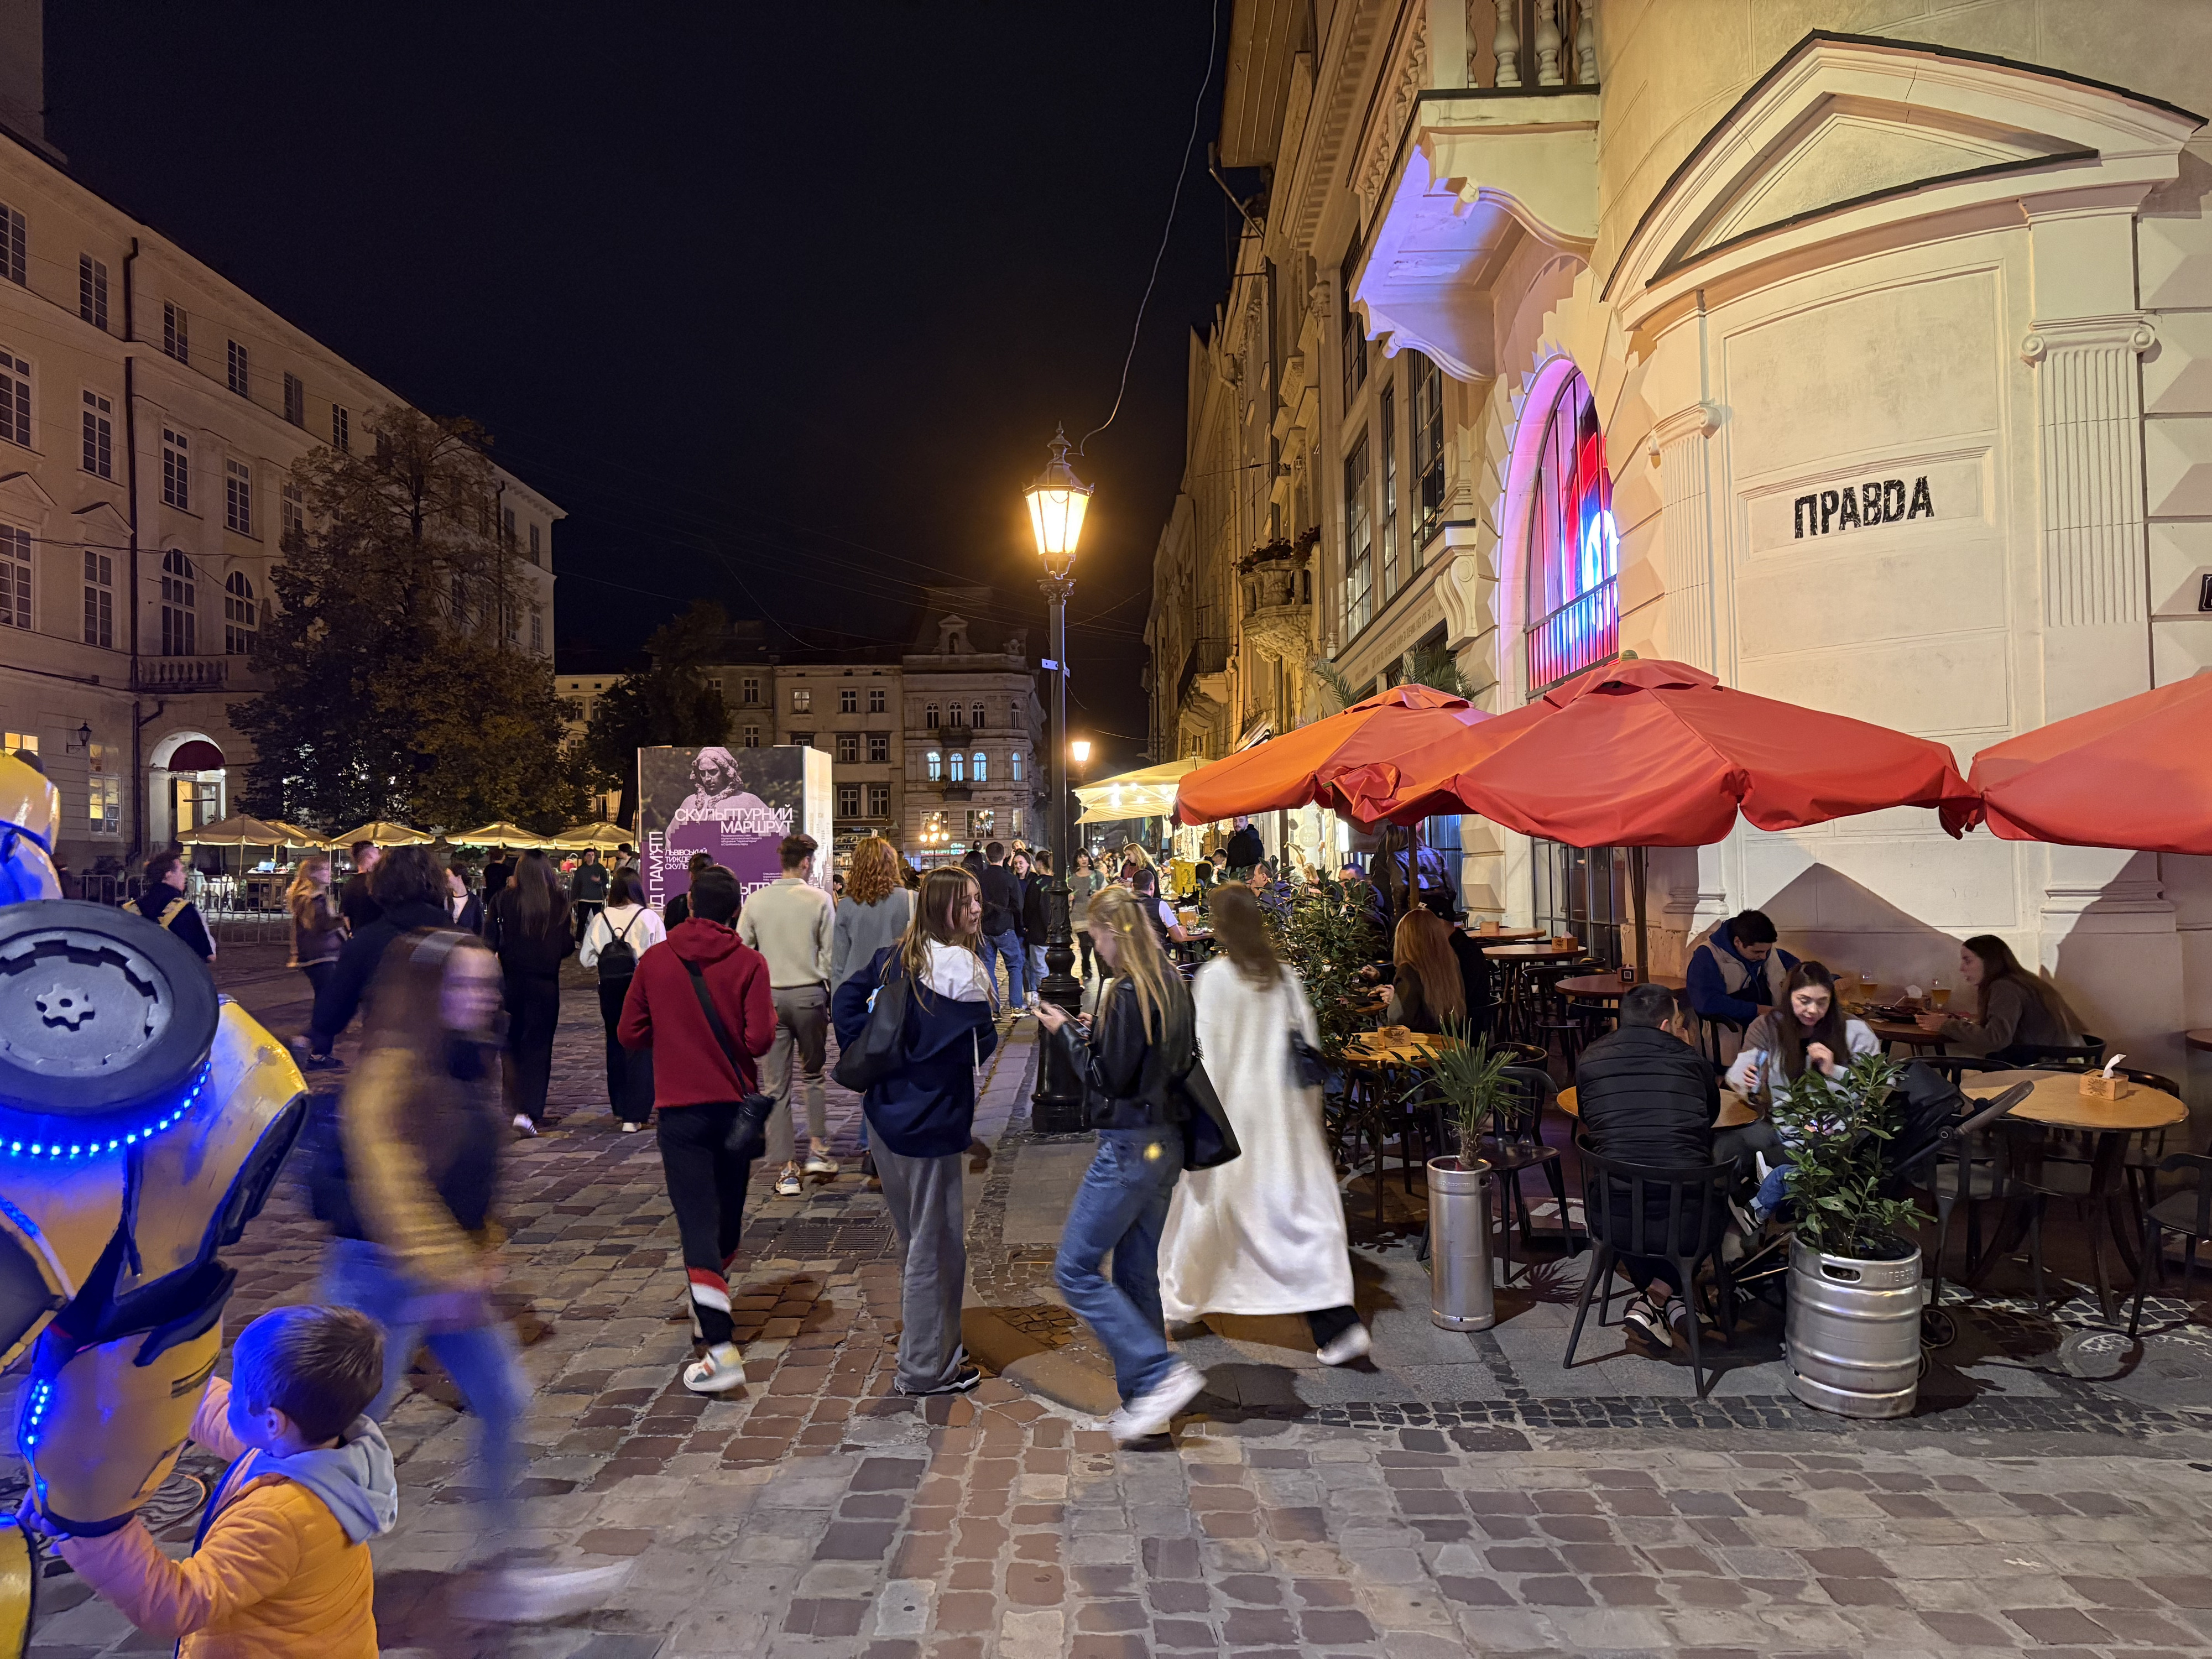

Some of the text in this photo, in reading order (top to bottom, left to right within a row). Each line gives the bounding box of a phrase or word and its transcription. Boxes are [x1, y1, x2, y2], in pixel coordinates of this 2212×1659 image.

[674, 804, 792, 822] СКУЛЬПТУРНИЙ
[721, 821, 794, 834] МАРШРУТ
[649, 894, 665, 912] ІД
